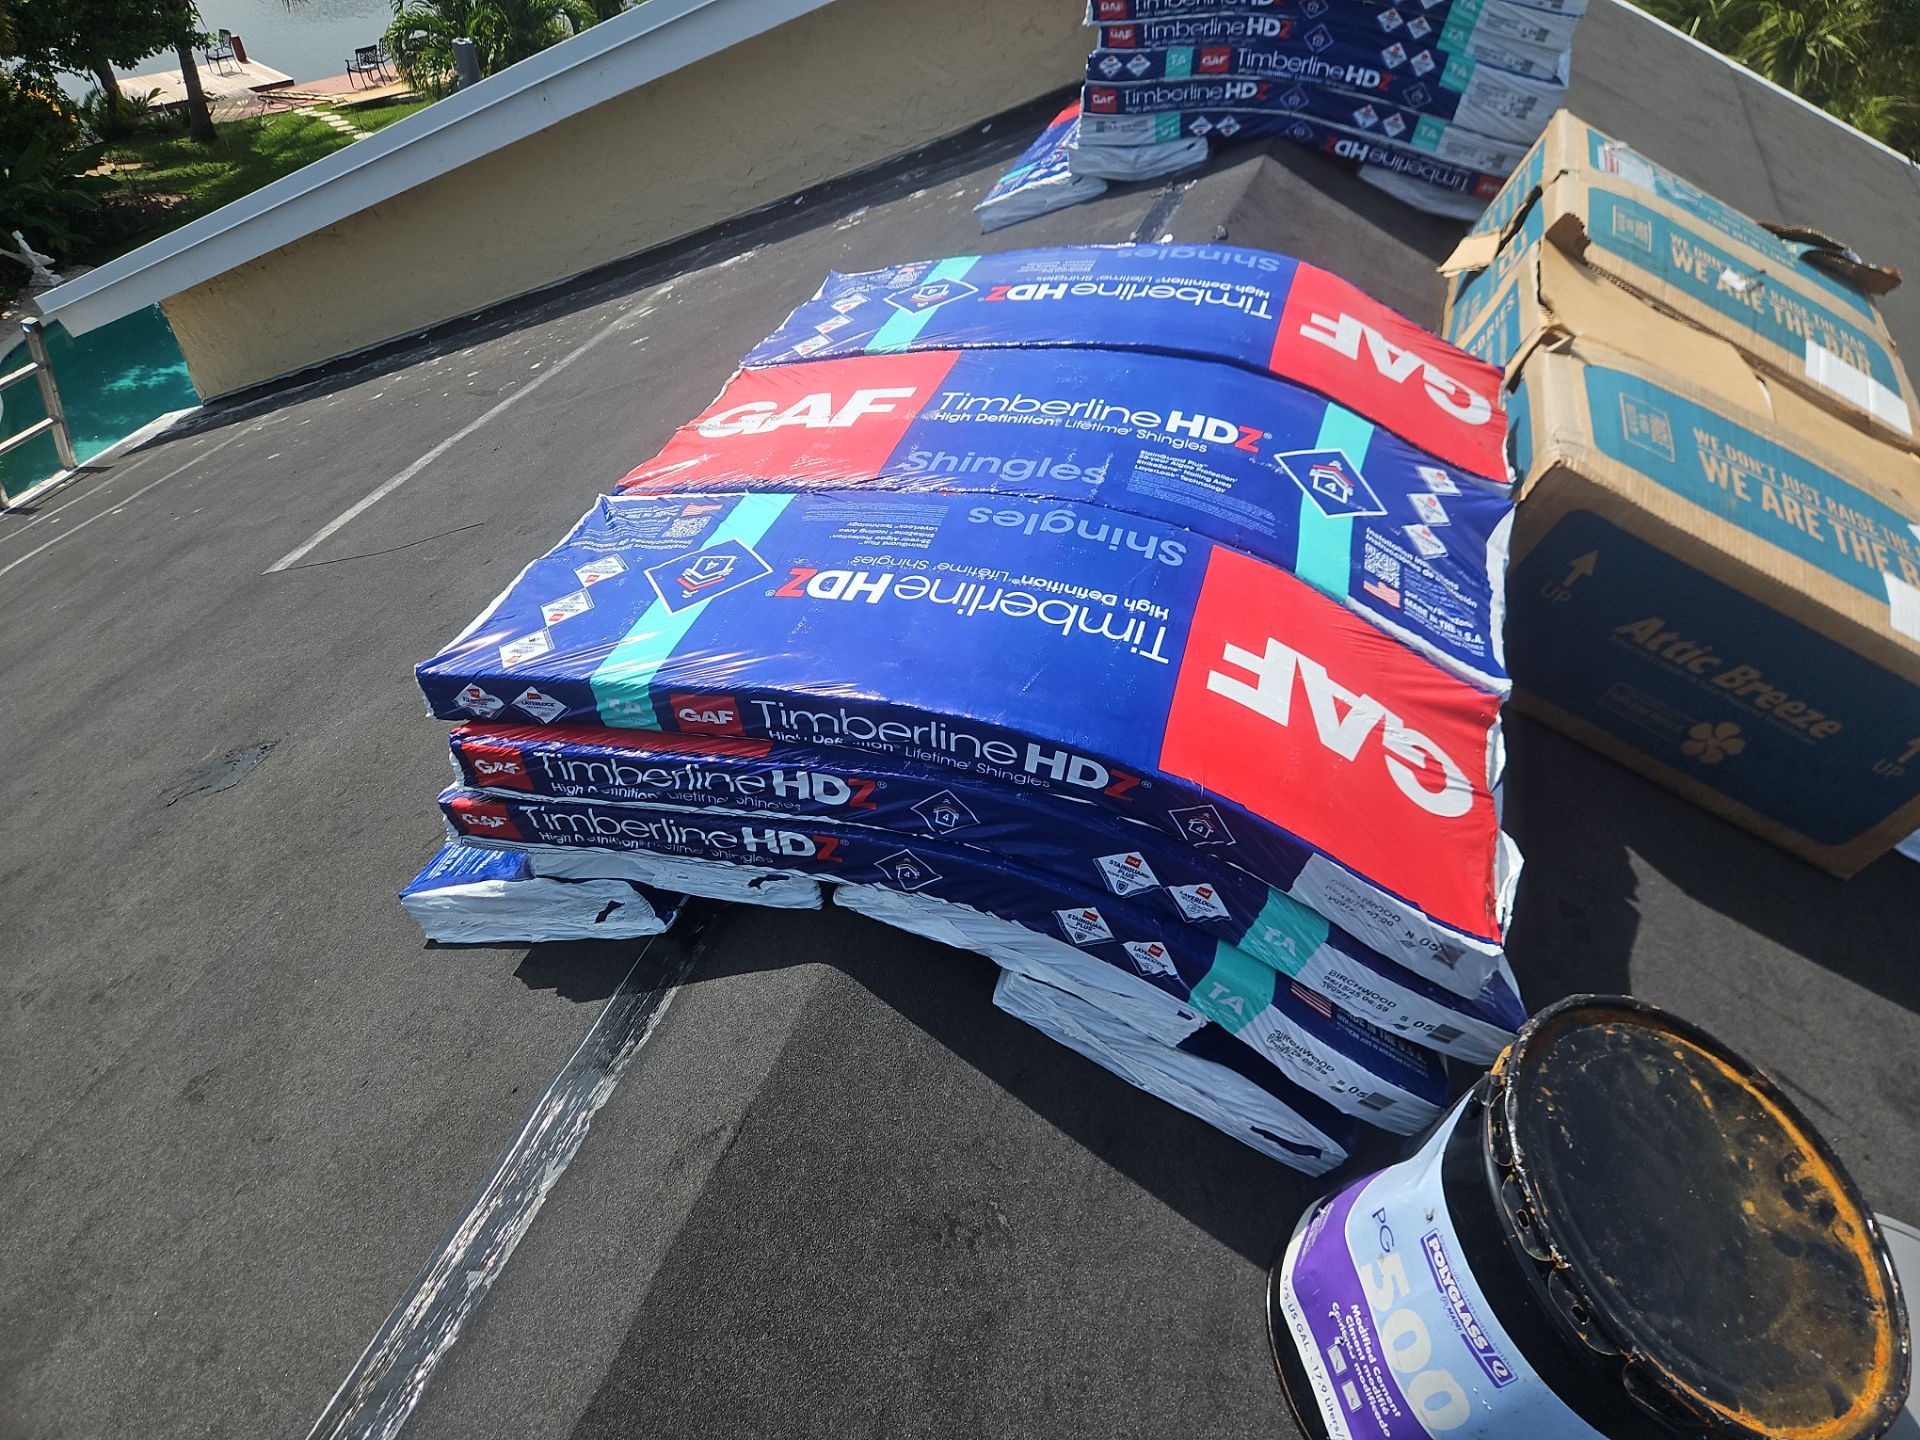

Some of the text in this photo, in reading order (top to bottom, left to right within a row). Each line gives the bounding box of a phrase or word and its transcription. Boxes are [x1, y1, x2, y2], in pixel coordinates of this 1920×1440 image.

[1144, 17, 1246, 38] Timberline
[1237, 48, 1345, 78] Timberline
[1125, 83, 1223, 105] Timberline
[1116, 247, 1280, 272] Shingles
[1071, 281, 1273, 320] Timberline
[1670, 245, 1709, 285] WE
[1773, 299, 1816, 346] THE
[1825, 333, 1872, 377] BAR
[1300, 312, 1492, 425] GAF
[698, 387, 917, 438] GAF
[940, 391, 1163, 429] Timberline
[1135, 428, 1209, 454] Shingles
[903, 450, 1108, 485] Shingles
[1692, 426, 1721, 451] WE
[1724, 441, 1776, 481] DON'T
[1781, 469, 1822, 506] JUST
[1825, 496, 1875, 534] RAISE
[1881, 521, 1913, 551] THE
[1698, 449, 1753, 503] WE
[1761, 492, 1825, 543] ARE
[1829, 519, 1890, 575] THE
[967, 505, 1188, 567] Shingles
[852, 554, 930, 573] Shingles
[1123, 599, 1170, 621] High
[1540, 582, 1572, 603] UP
[893, 574, 1170, 665] Timberline
[1614, 616, 1725, 675] Attic
[1711, 663, 1844, 740] Breeze
[678, 707, 735, 726] GAF
[750, 700, 1019, 766] Timberline
[1206, 636, 1475, 818] GAF
[475, 758, 520, 775] GAF
[533, 752, 765, 795] Timberline
[975, 762, 1052, 788] Shingles
[1872, 758, 1904, 778] UP
[462, 812, 509, 828] GAF
[518, 806, 738, 848] Timberline
[1207, 981, 1245, 1017] TA
[1327, 969, 1398, 1009] BIRCHWOOD
[1412, 1020, 1435, 1032] 05
[1287, 1303, 1299, 1321] US
[1428, 1235, 1489, 1351] POLYGLASS
[1350, 1304, 1401, 1418] Modified Cement
[1360, 1252, 1471, 1432] 500
[1345, 1315, 1391, 1416] Ciment modifié
[1352, 1361, 1392, 1438] modificado
